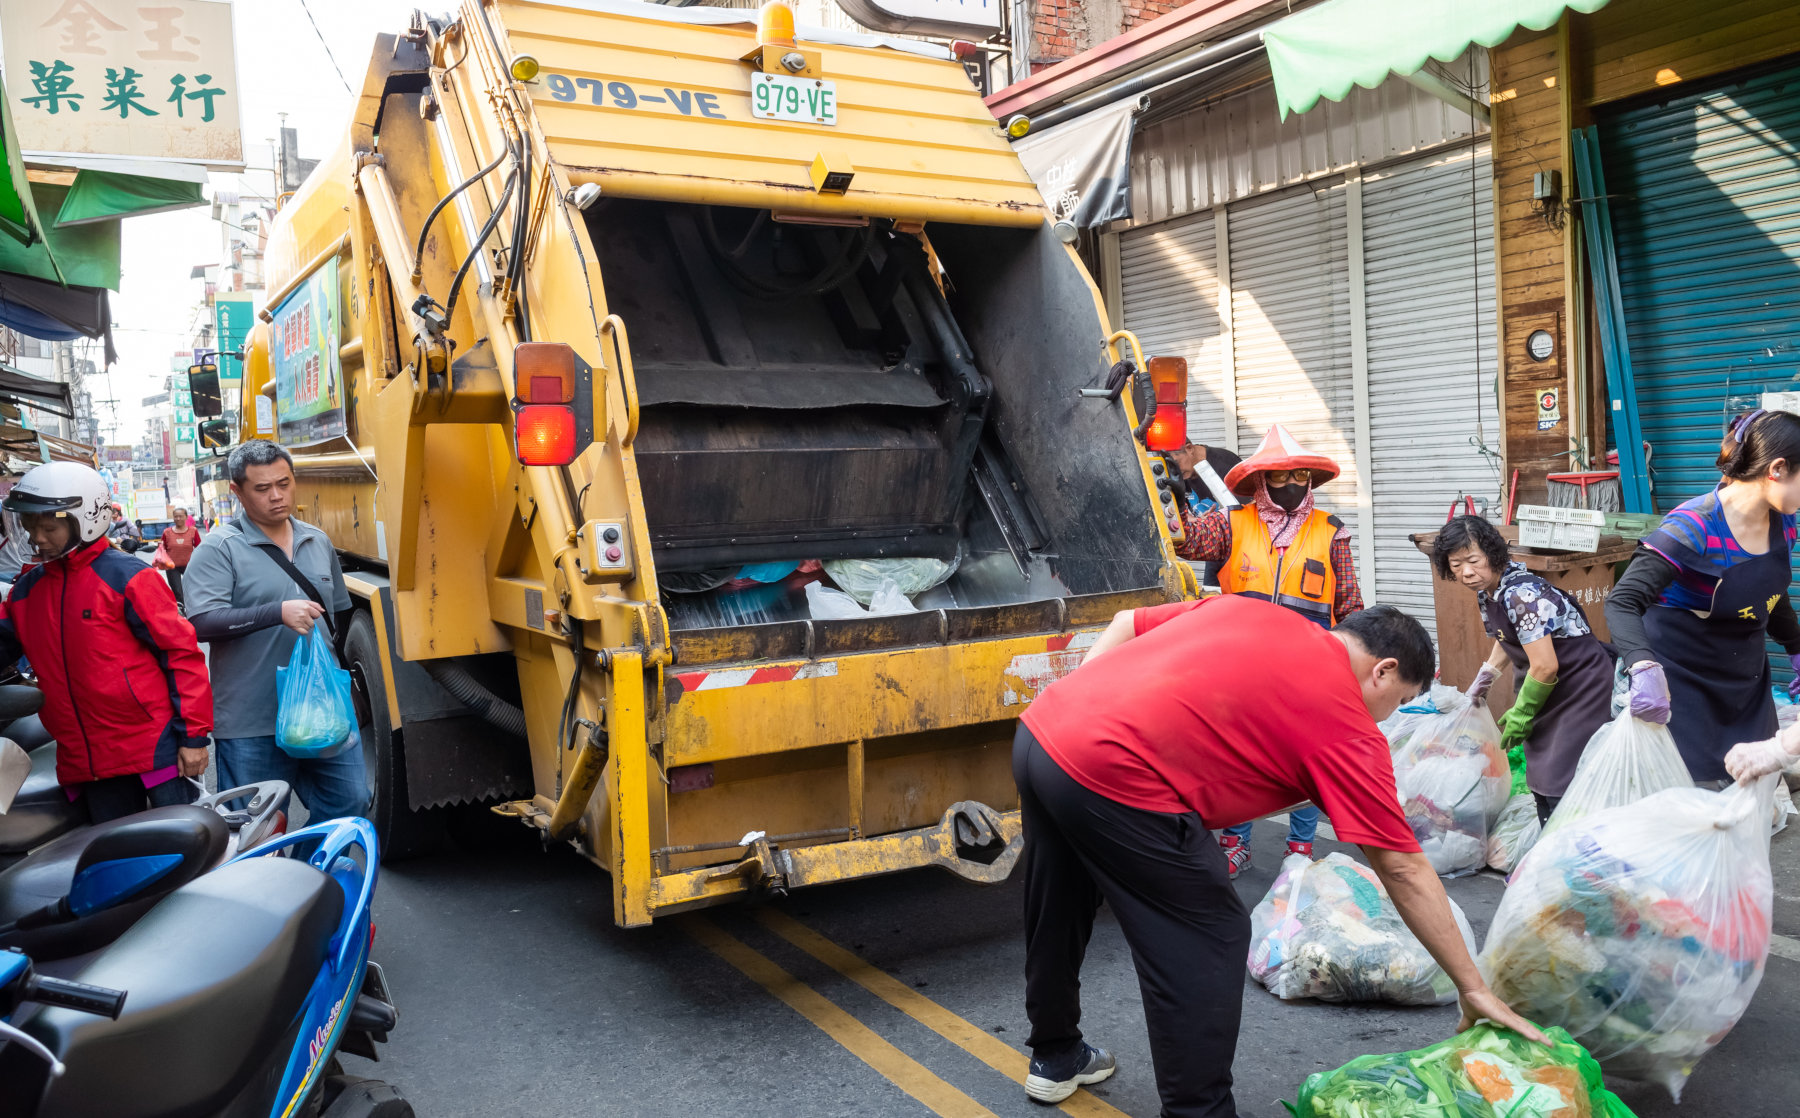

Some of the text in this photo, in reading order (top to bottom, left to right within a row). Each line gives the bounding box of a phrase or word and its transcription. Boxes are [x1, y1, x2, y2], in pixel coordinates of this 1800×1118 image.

[38, 0, 201, 62] 金玉
[20, 59, 226, 123] 菓菜行
[546, 73, 727, 119] 979-VE
[756, 83, 834, 119] 979-VE
